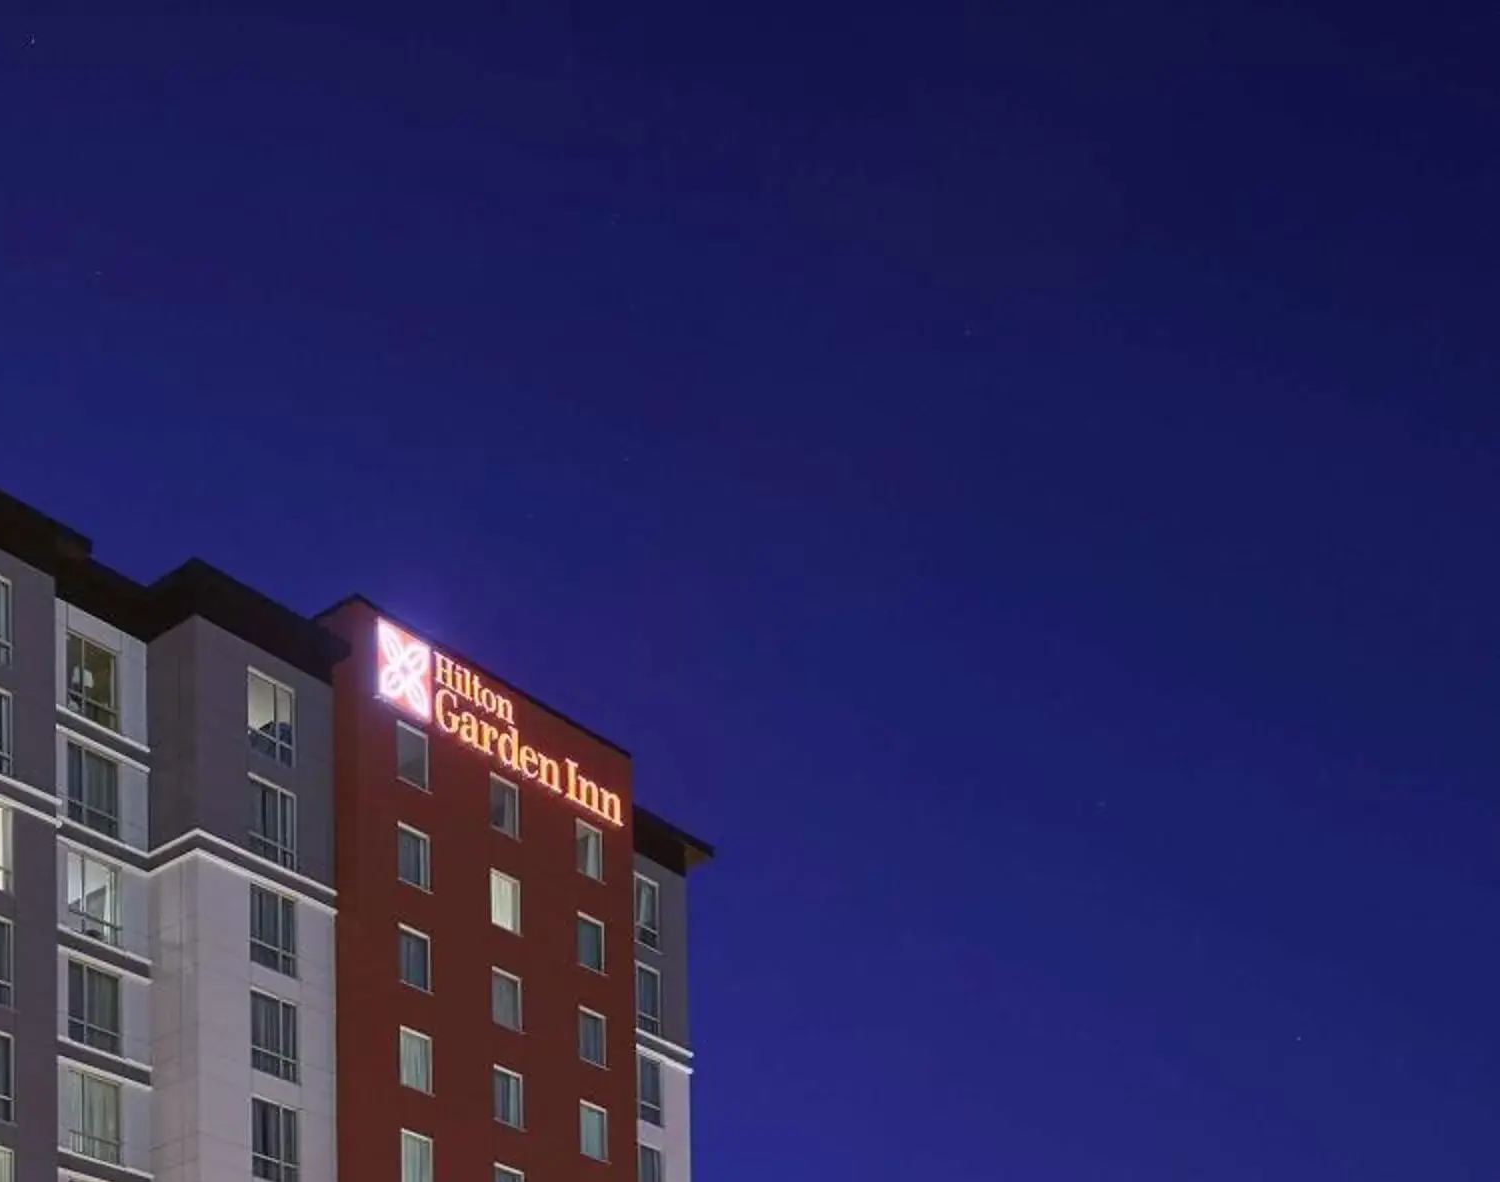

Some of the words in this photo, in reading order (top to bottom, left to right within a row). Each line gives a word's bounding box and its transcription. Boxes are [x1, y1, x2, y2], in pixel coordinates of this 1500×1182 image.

[434, 651, 515, 725] Hilton
[435, 690, 562, 794] Garden
[565, 757, 624, 828] Inn
